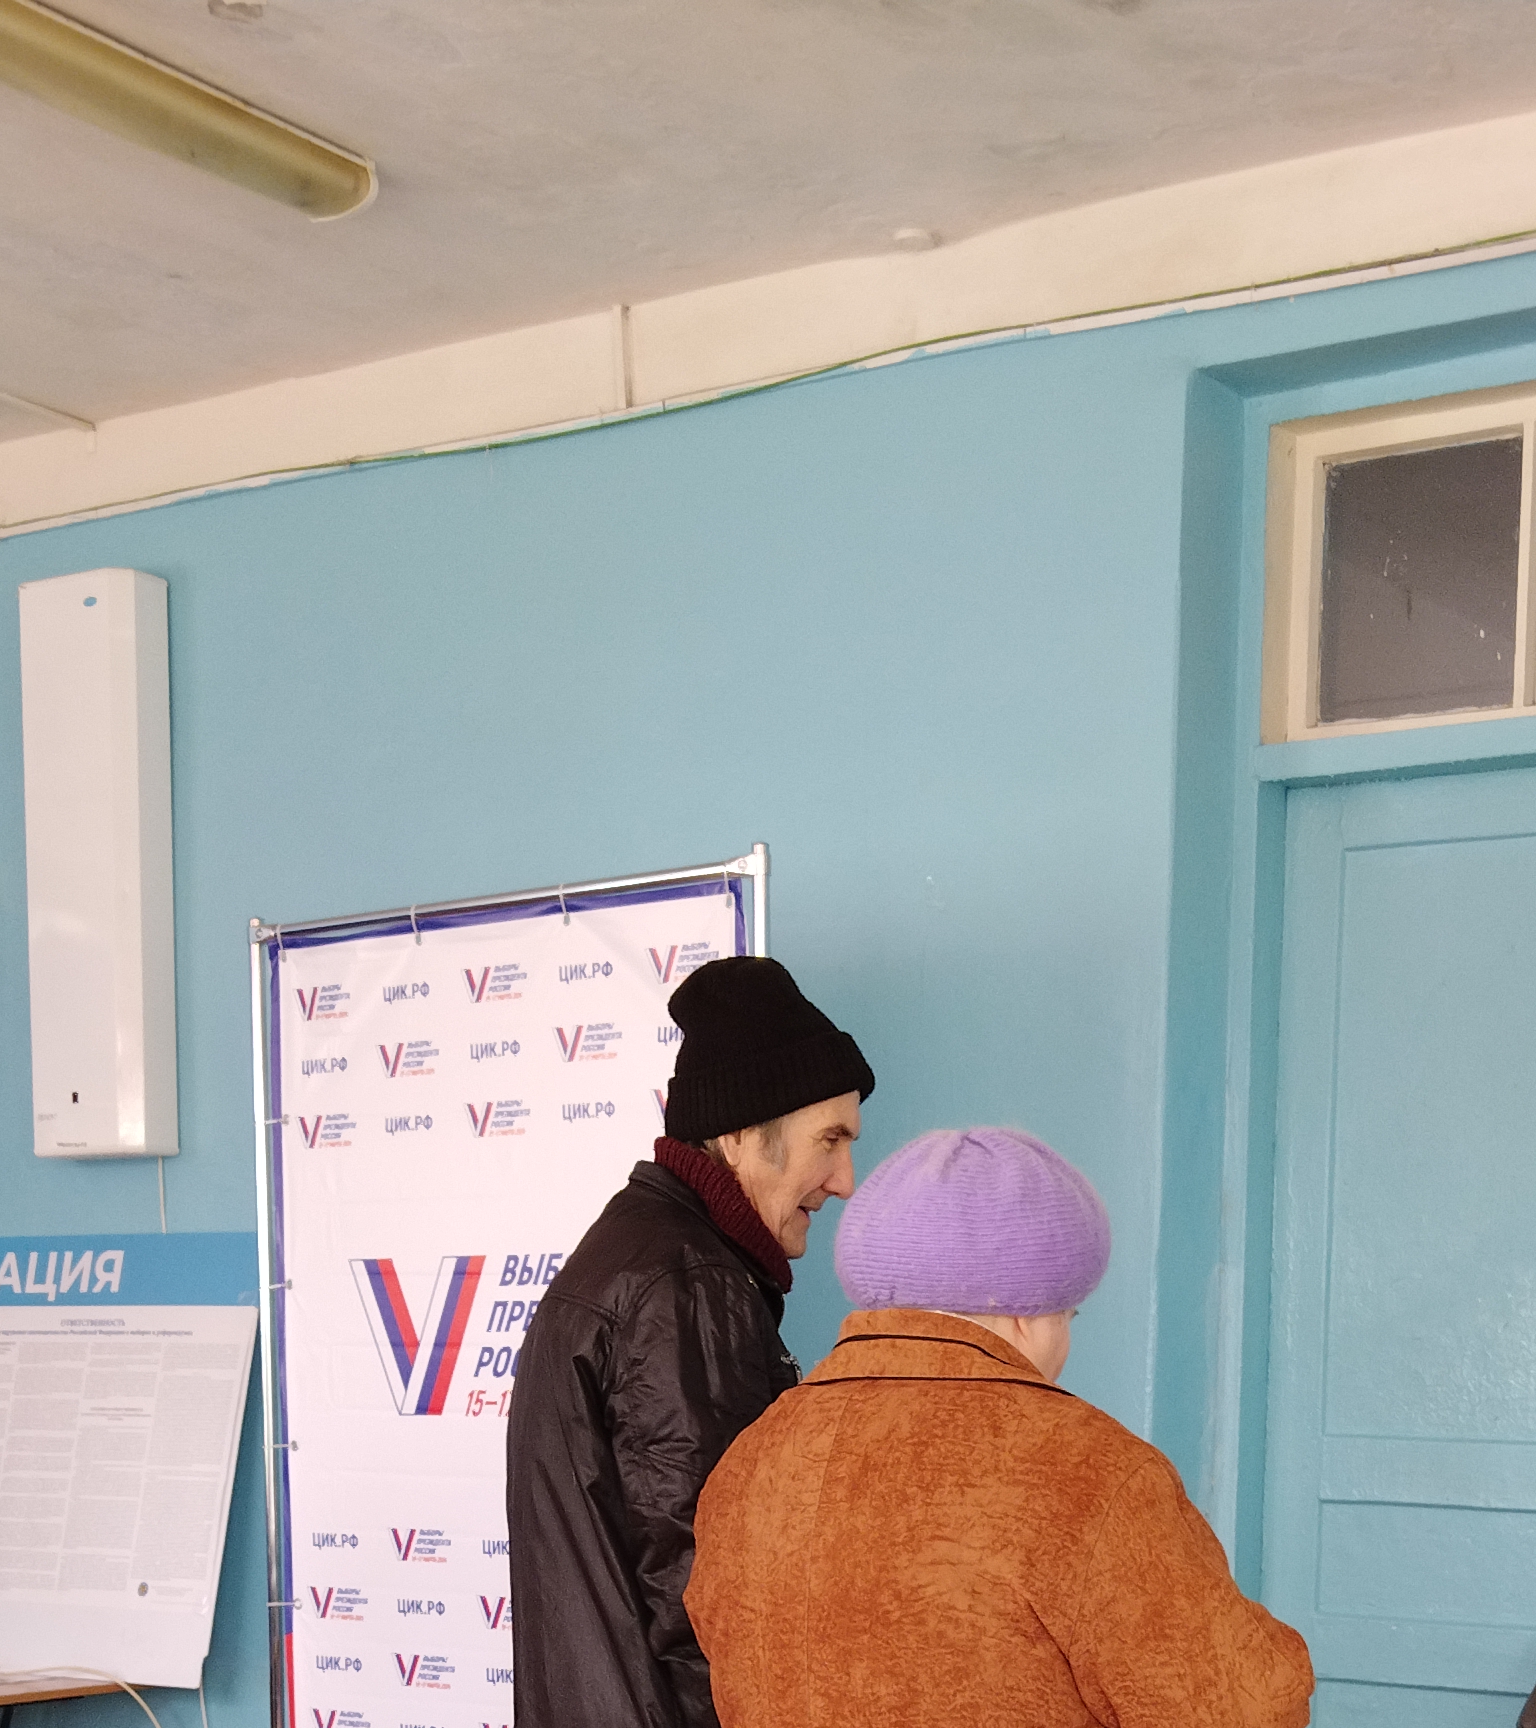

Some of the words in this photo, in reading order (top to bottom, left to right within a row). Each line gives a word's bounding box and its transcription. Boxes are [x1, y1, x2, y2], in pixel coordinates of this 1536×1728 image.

[559, 961, 613, 984] ЦИК.РФ
[383, 982, 430, 1004] ЦИК.РФ
[470, 1040, 520, 1062] ЦИК.РФ
[302, 1057, 347, 1077] ЦИК.РФ
[562, 1101, 615, 1123] ЦИК.РФ
[385, 1115, 433, 1135] ЦИК.РФ
[499, 1253, 563, 1286] ВЫБ
[312, 1532, 358, 1548] ЦИК.РФ
[482, 1540, 510, 1558] ЦИК
[398, 1599, 445, 1617] ЦИК.РФ
[316, 1656, 362, 1673] ЦИК.РФ
[486, 1668, 513, 1686] ЦИК
